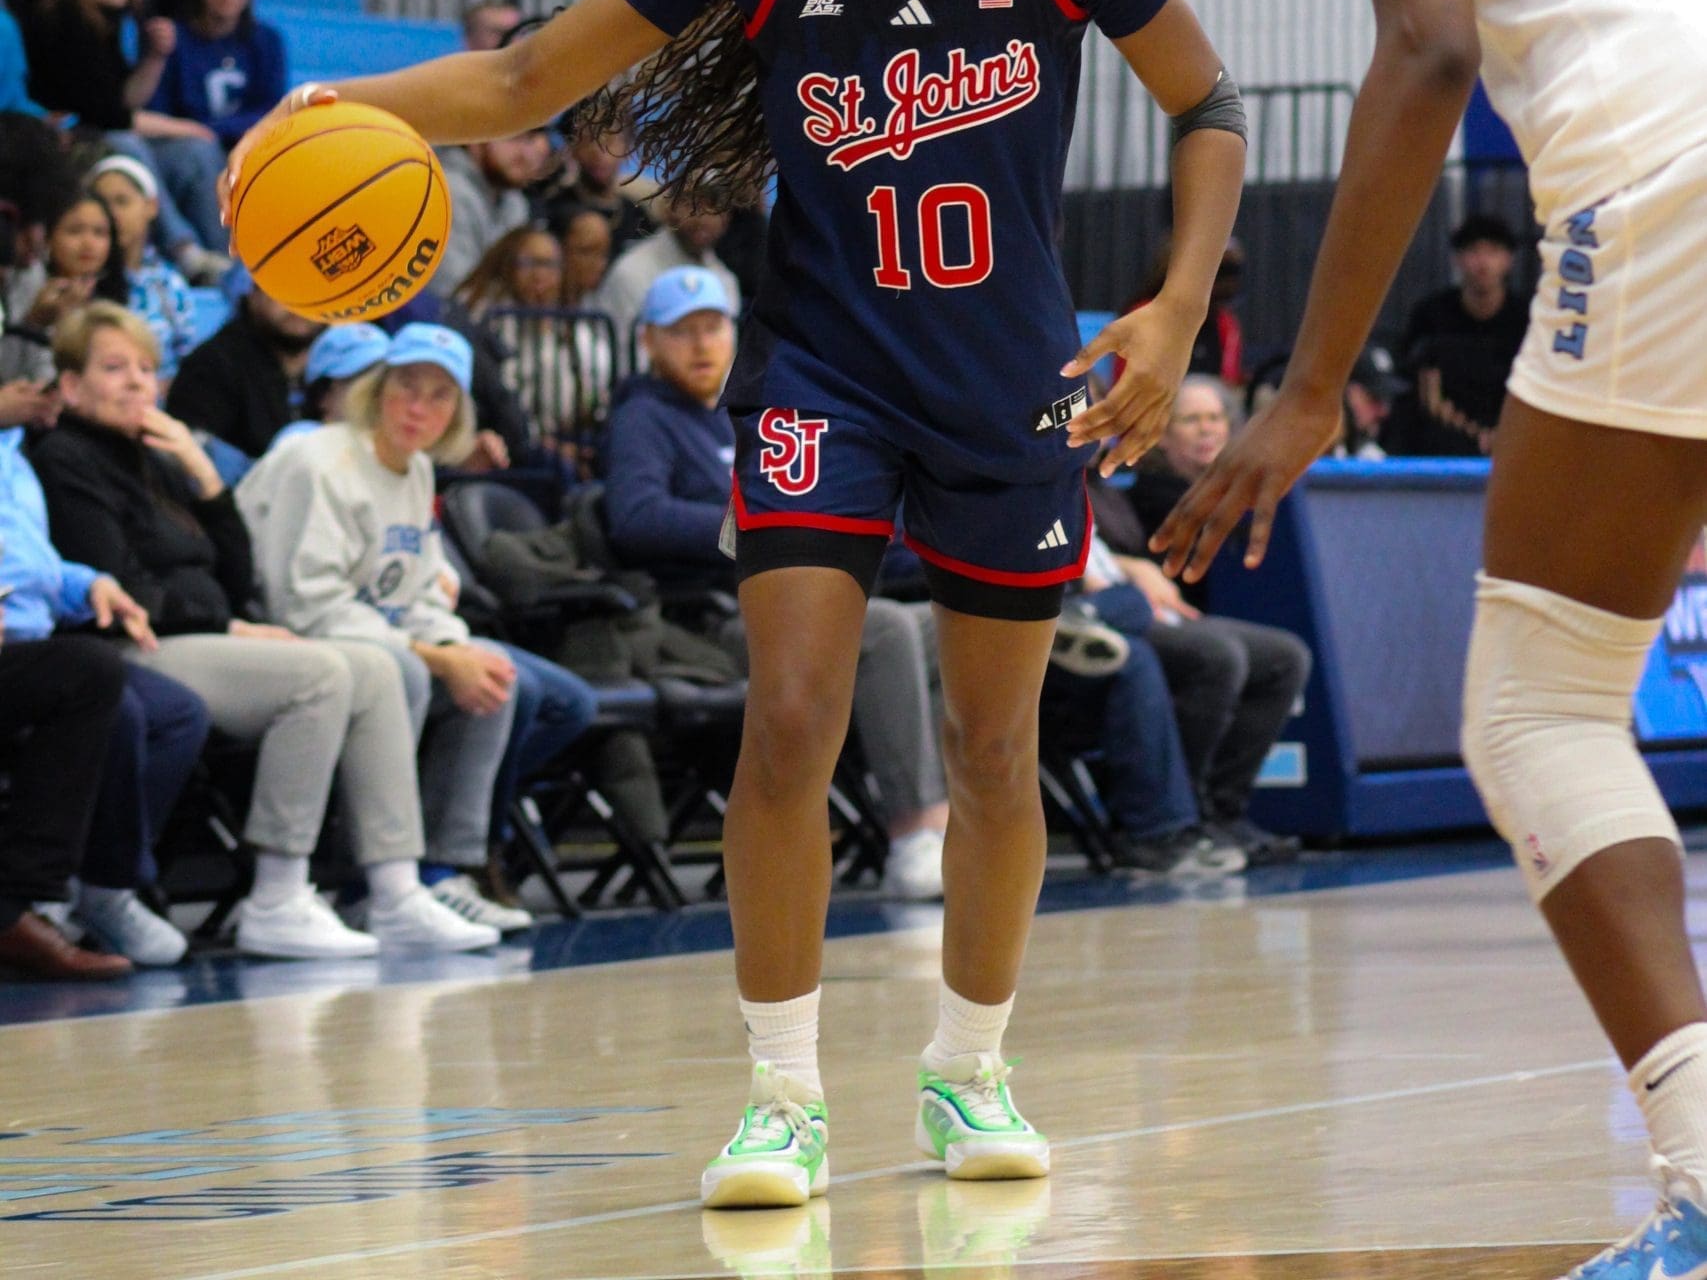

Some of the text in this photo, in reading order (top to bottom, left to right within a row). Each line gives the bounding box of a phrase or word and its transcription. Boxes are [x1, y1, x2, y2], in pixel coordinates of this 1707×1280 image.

[801, 4, 844, 14] EAST
[797, 39, 1041, 160] St. John's
[867, 183, 994, 290] 10
[1, 1150, 676, 1220] COURT
